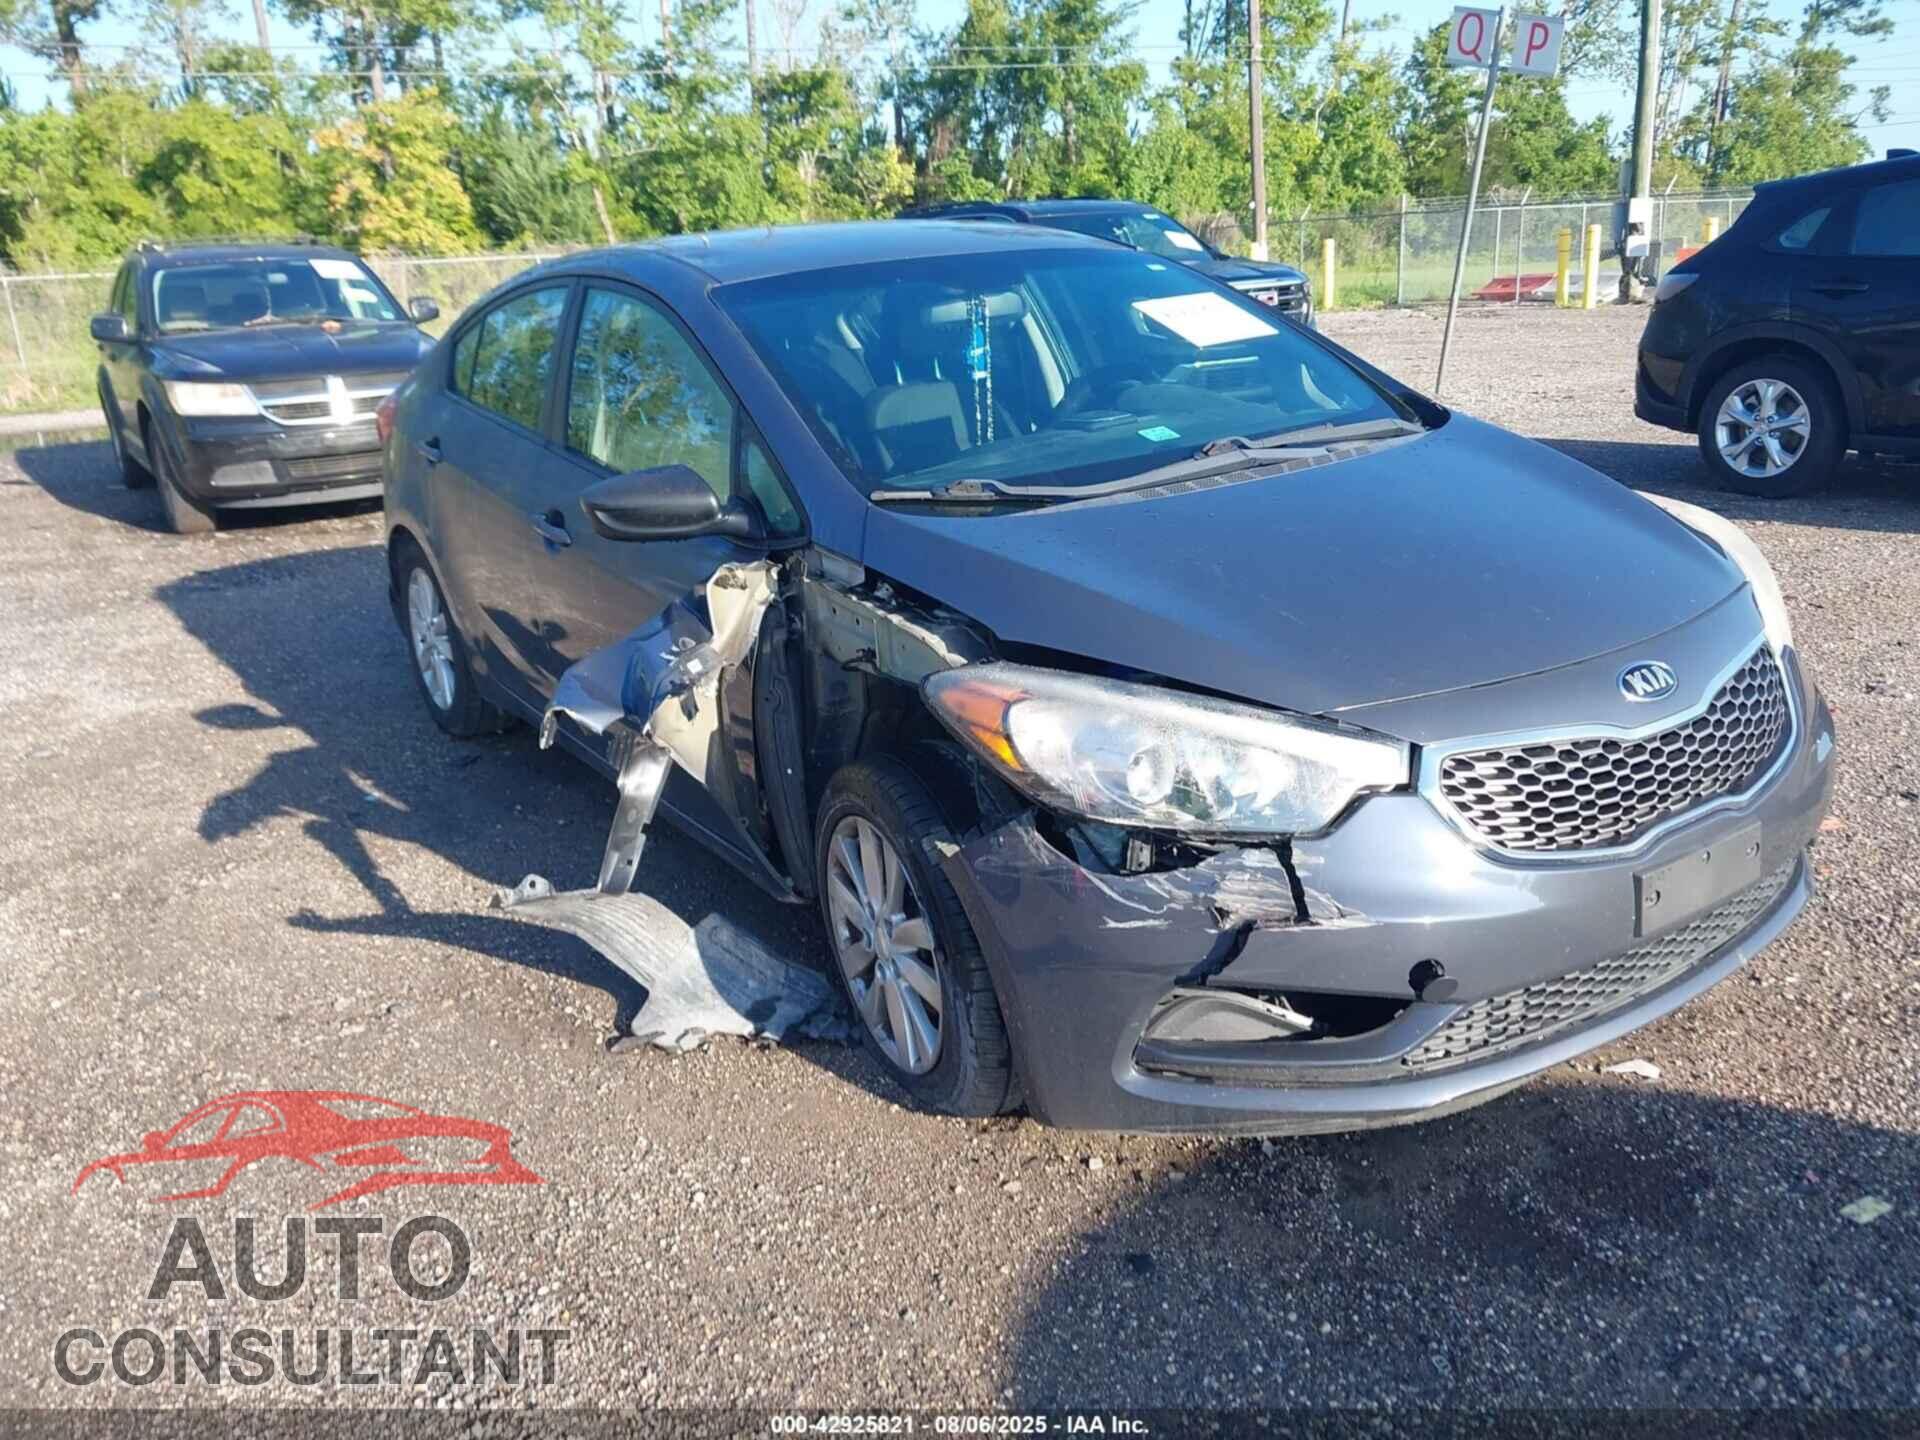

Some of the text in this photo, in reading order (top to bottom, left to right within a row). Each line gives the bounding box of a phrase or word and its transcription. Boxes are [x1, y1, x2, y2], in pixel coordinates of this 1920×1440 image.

[1457, 12, 1484, 63] Q
[1524, 21, 1549, 67] P
[1625, 665, 1674, 696] KIA
